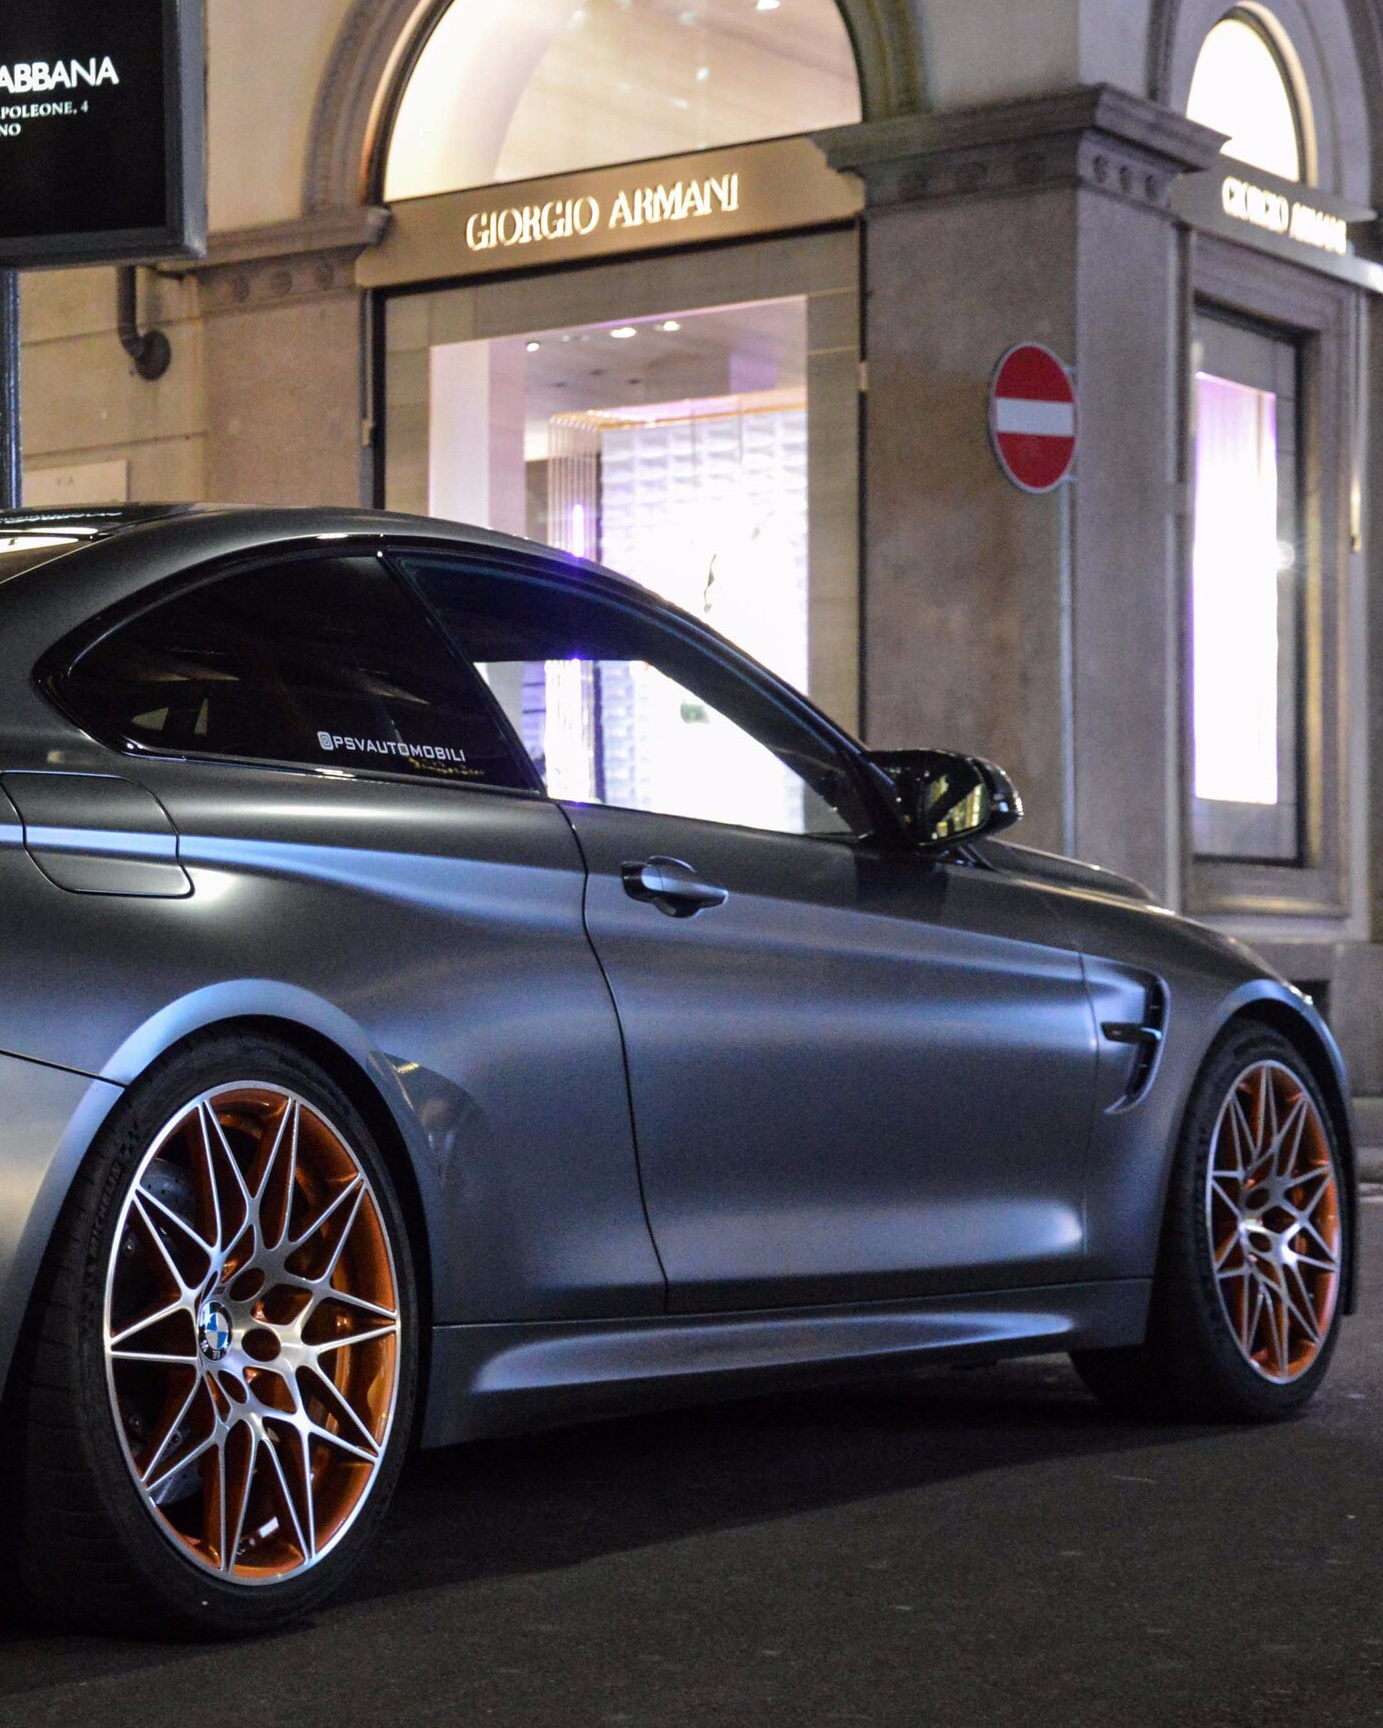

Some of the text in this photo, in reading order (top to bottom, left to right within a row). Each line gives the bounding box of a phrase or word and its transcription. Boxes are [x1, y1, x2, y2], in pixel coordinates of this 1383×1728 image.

[80, 100, 89, 113] 4
[466, 172, 739, 251] GIORGIO ARMANI
[331, 735, 467, 762] PSVAUTOMOBILI
